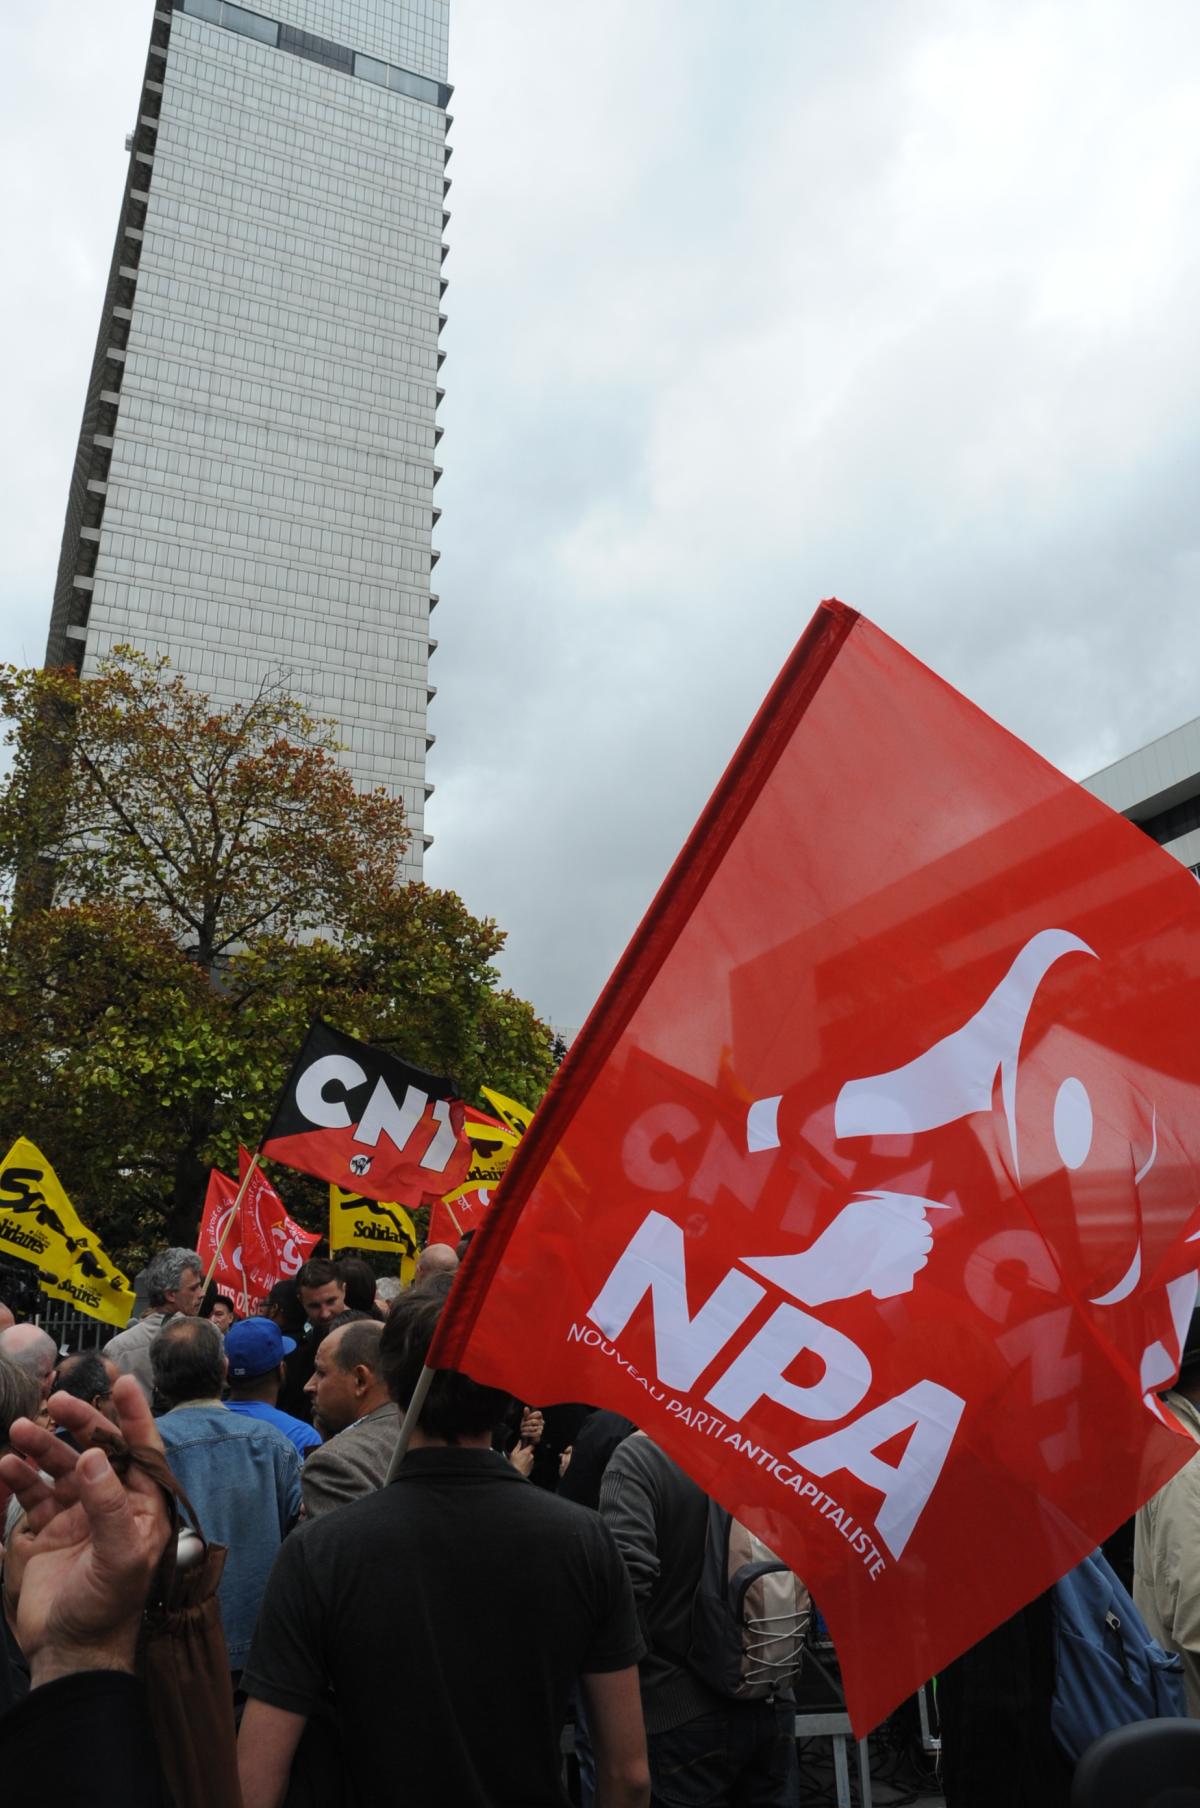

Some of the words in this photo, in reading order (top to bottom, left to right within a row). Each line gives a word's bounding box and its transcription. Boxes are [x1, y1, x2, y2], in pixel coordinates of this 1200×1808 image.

[0, 1217, 46, 1255] lidaires
[566, 1322, 665, 1401] NOUVEAU
[665, 1399, 727, 1439] PARTI
[723, 1432, 886, 1581] ANTICAPITALISTE
[586, 1209, 966, 1563] NPA
